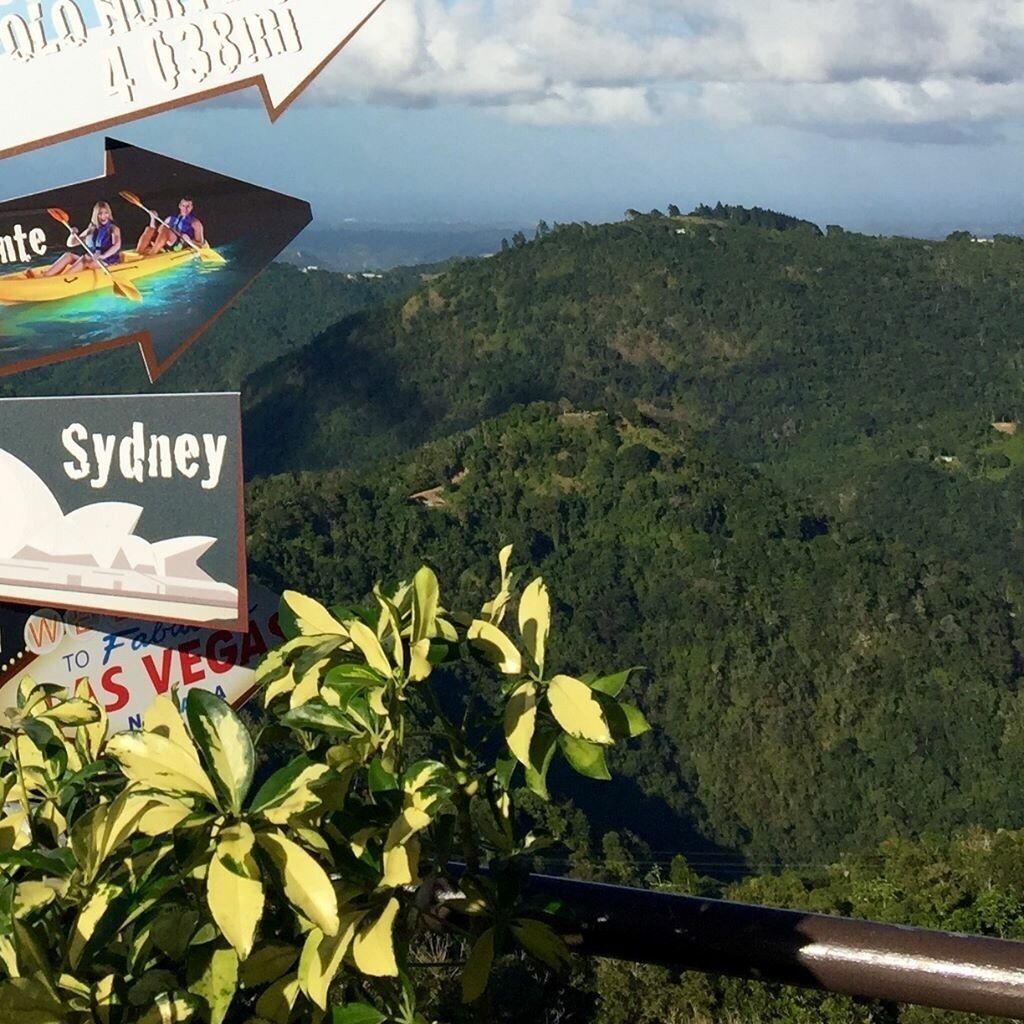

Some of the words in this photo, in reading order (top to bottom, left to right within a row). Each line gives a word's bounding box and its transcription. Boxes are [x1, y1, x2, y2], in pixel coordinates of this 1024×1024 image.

[102, 44, 136, 103] 4
[62, 421, 228, 490] Sydney
[63, 649, 90, 672] TO
